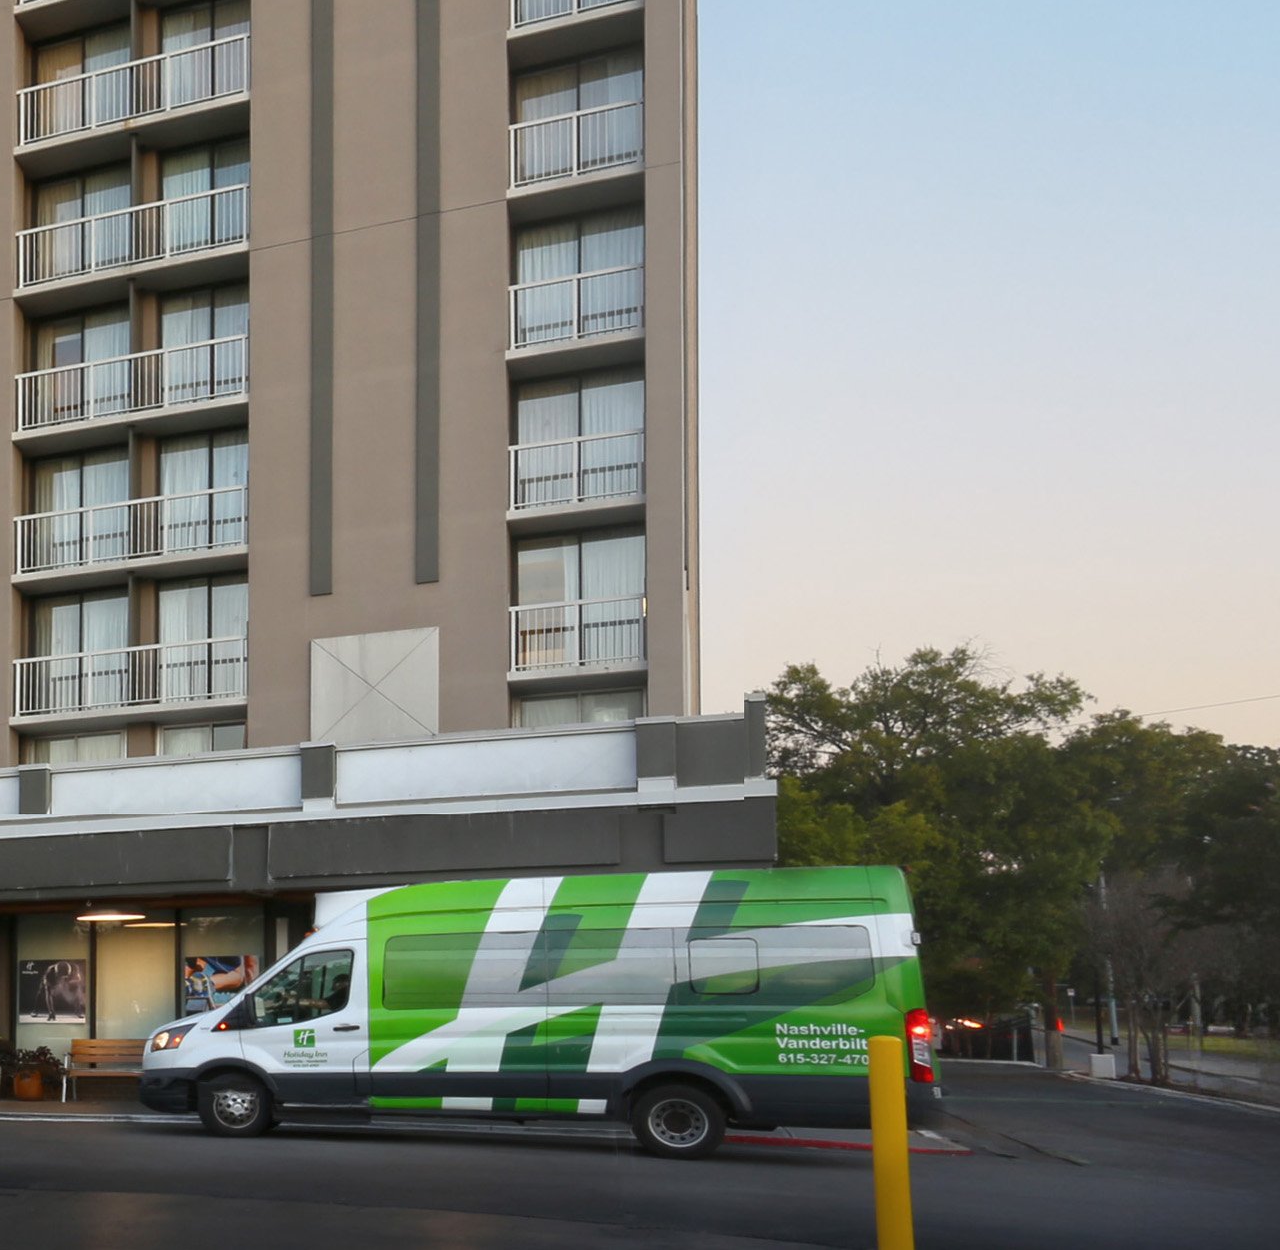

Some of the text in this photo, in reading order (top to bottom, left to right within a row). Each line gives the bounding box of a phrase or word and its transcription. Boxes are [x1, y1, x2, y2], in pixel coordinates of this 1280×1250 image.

[775, 1023, 865, 1036] Nashville-
[776, 1037, 868, 1050] Vanderbilt
[283, 1050, 315, 1059] Holiday
[778, 1053, 870, 1066] 615-327-470
